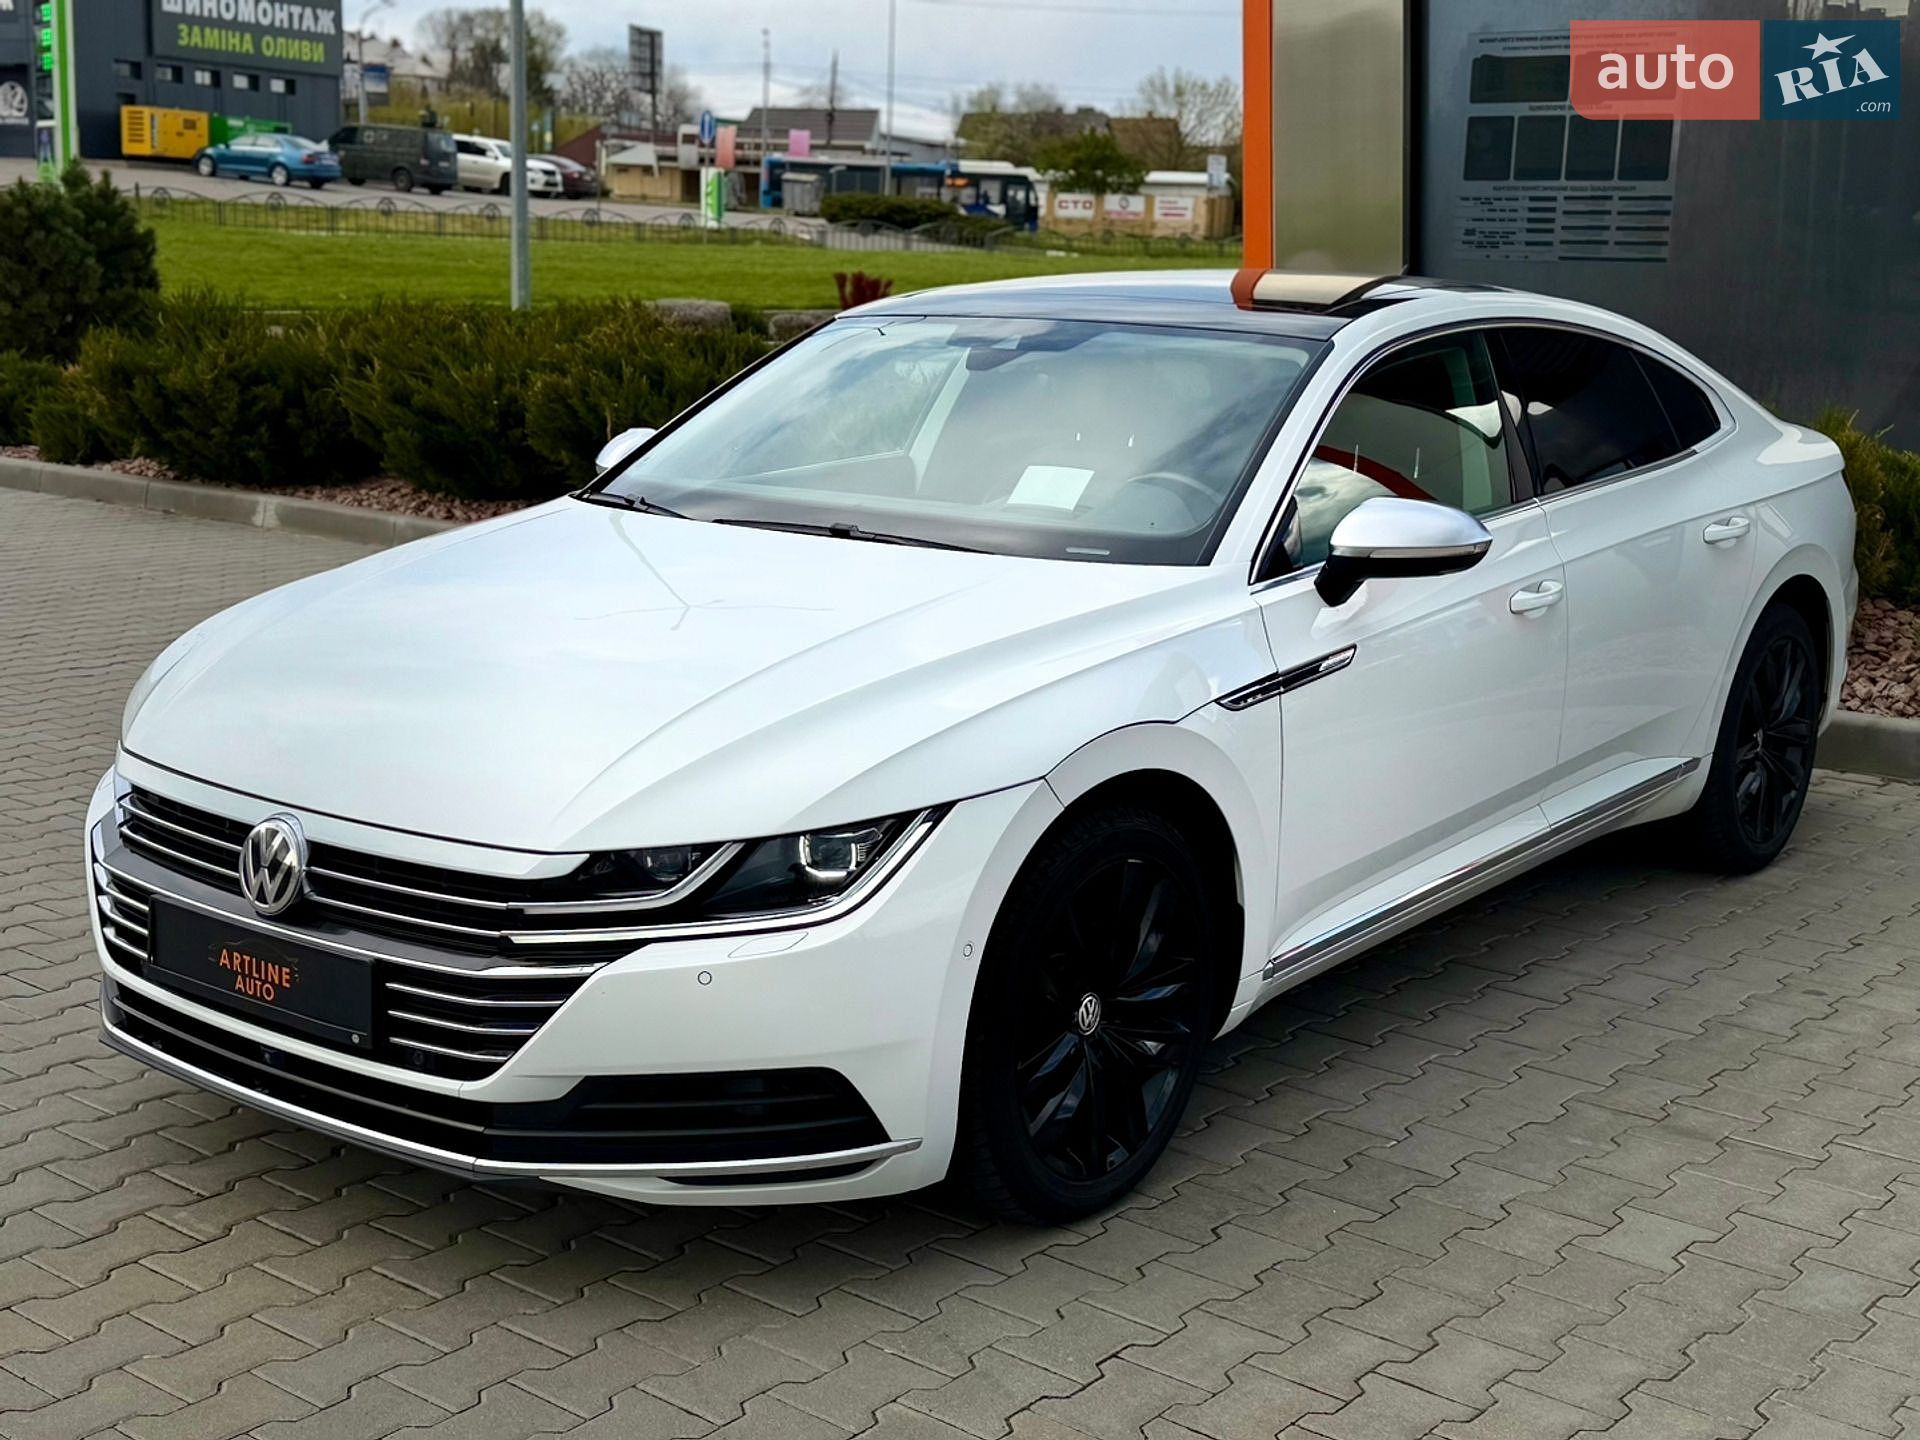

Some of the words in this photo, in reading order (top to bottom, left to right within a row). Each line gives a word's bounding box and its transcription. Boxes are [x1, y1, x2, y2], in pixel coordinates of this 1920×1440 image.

[161, 0, 336, 35] ШИНОМОНТАЖ
[177, 24, 254, 54] ЗАМІНА
[261, 35, 325, 63] ОЛИВИ
[1058, 200, 1094, 210] СТО
[241, 822, 299, 911] VW
[219, 948, 292, 989] ARTLINE
[234, 974, 275, 1001] AUTO
